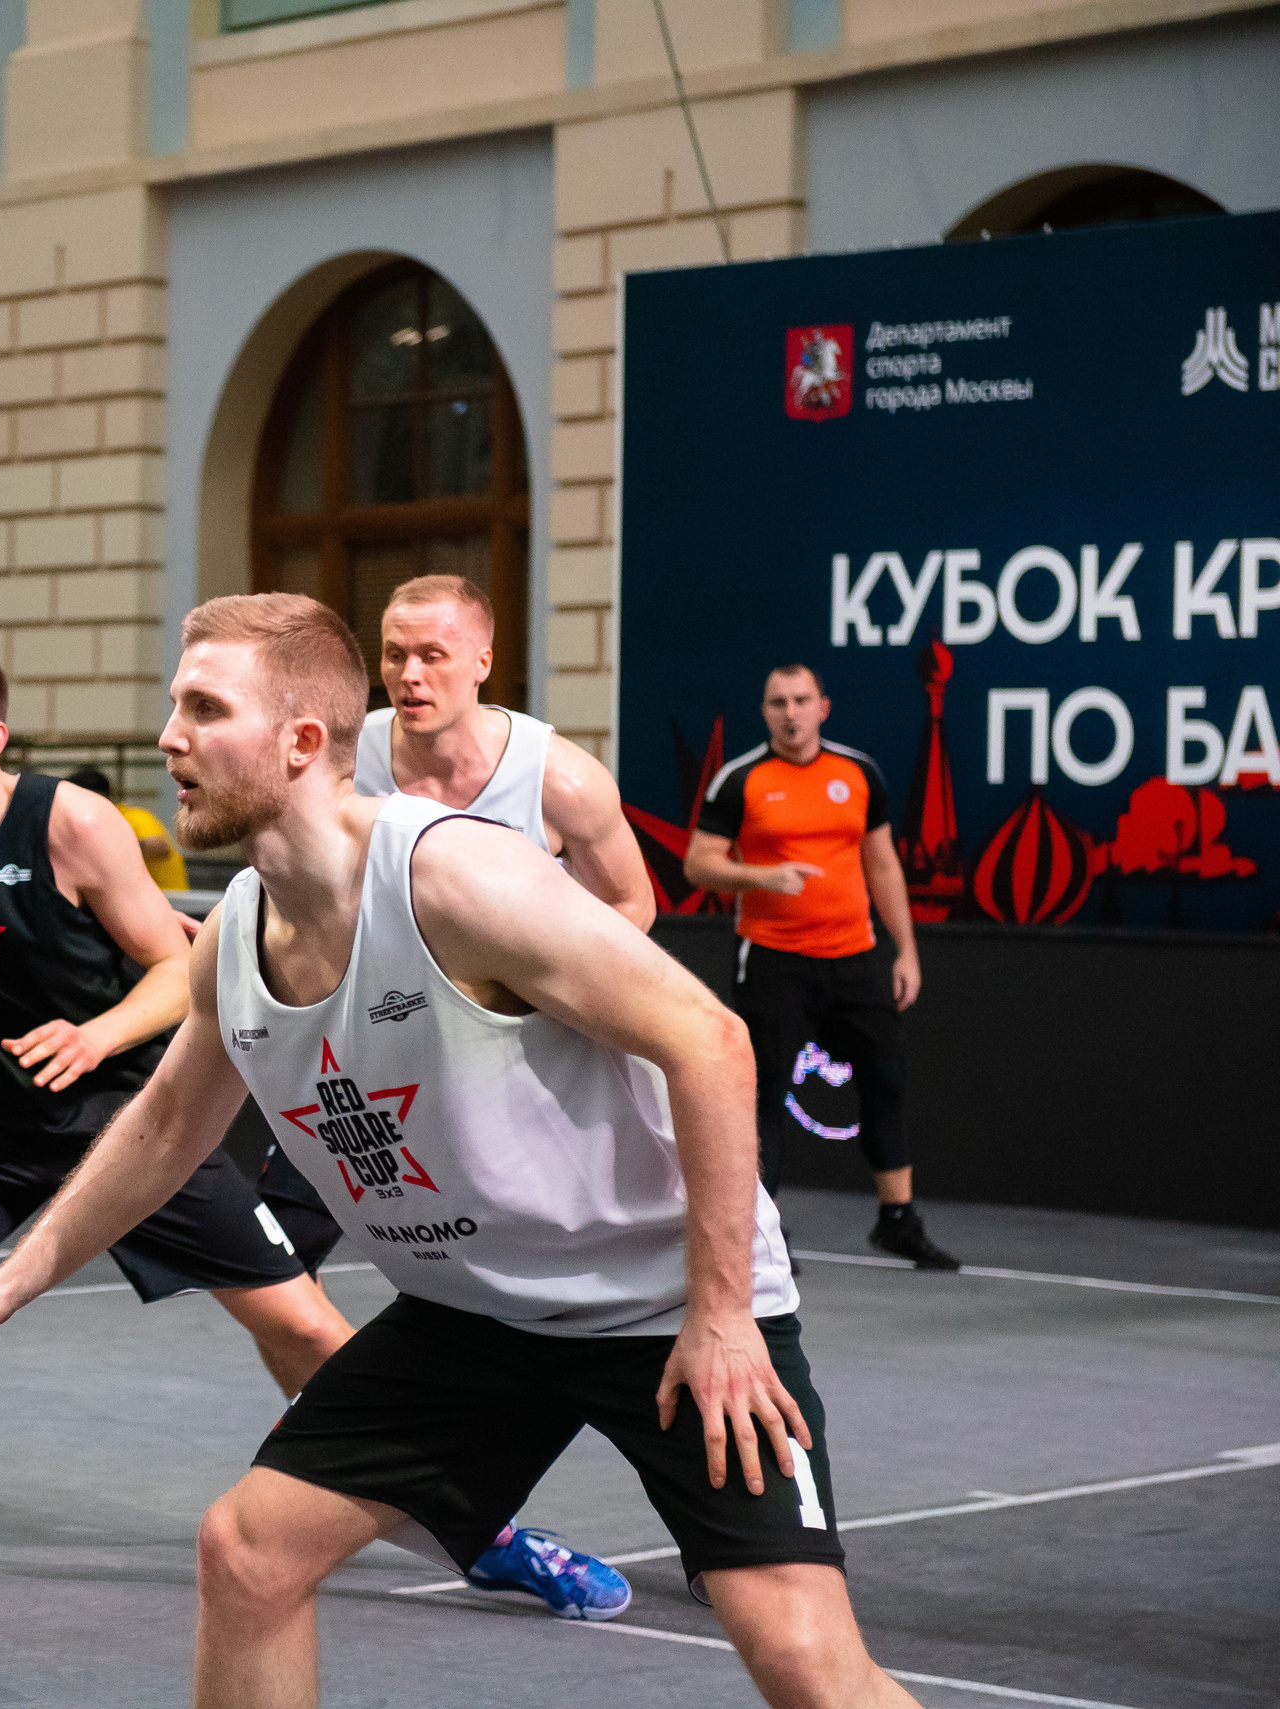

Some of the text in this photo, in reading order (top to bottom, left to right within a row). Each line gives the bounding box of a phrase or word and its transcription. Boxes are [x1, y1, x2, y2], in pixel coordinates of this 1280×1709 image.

[865, 316, 1013, 352] Департамент
[865, 352, 942, 382] спорта
[865, 377, 1034, 414] города Москвы
[830, 537, 1280, 647] КУБОК КР
[986, 685, 1280, 787] ПО БА
[317, 1078, 366, 1117] RED
[317, 1111, 403, 1158] SQUARE
[350, 1149, 400, 1187] CUP
[366, 1217, 478, 1244] INANOMO
[413, 1250, 451, 1261] RUSSIA
